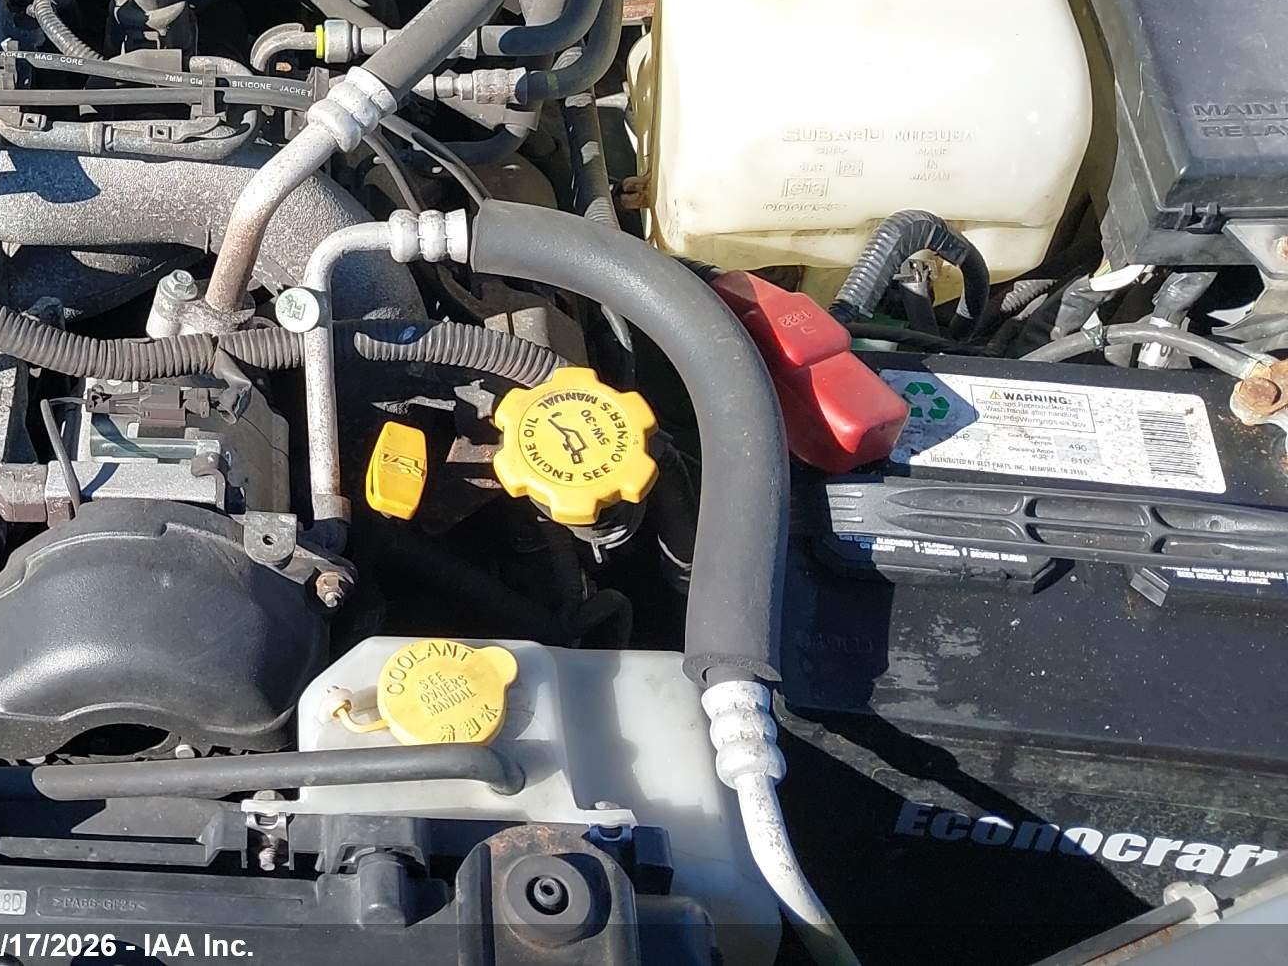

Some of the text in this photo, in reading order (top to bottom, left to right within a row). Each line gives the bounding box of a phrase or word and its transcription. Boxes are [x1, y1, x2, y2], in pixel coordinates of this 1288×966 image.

[34, 53, 53, 62] MAG
[60, 56, 84, 66] CORE
[164, 73, 184, 84] 7MM
[231, 80, 272, 91] SILICONE
[278, 84, 312, 98] JACKET
[1192, 103, 1278, 116] MAIN
[1003, 391, 1072, 406] WARNING:
[523, 392, 628, 482] ENGINE OIL SEE OWNER'S MANUAL
[386, 642, 475, 696] COOLANT
[419, 670, 446, 690] SEE
[420, 674, 469, 704] OWNERS
[426, 687, 477, 717] MANUAL
